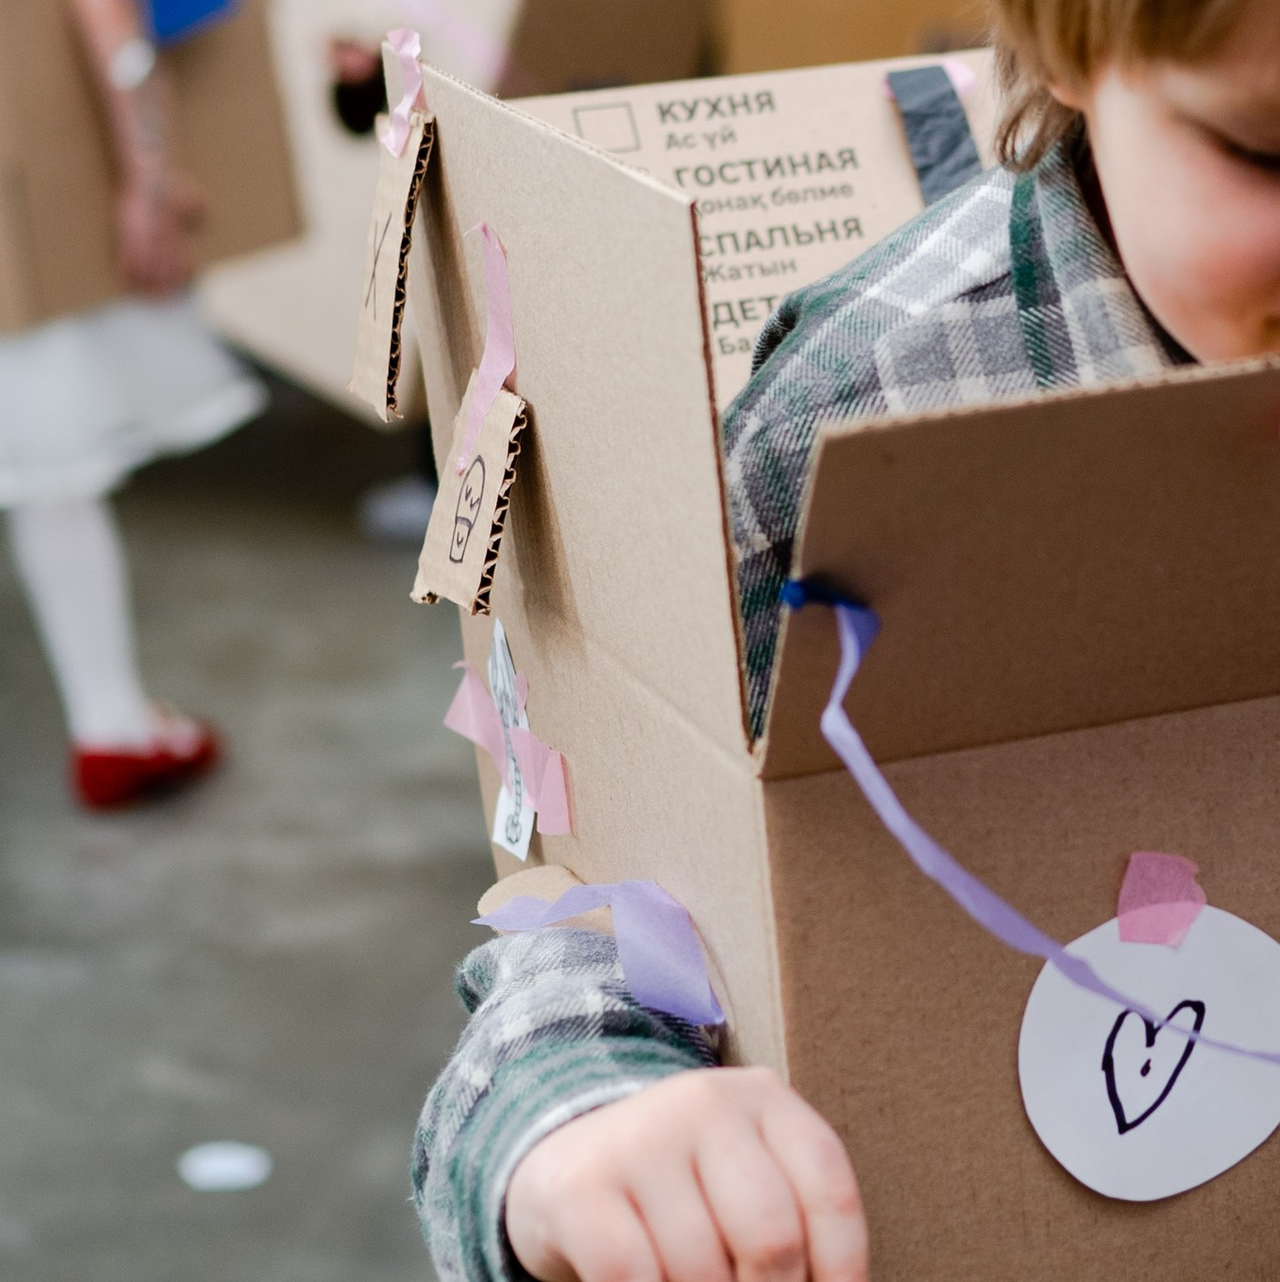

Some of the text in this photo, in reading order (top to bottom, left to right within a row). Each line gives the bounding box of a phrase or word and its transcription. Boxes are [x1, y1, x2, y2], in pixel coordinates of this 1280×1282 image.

[657, 90, 775, 124] КУХНЯ
[665, 132, 697, 150] Ас
[675, 148, 858, 186] ГОСТИНАЯ
[694, 191, 768, 217] онақ
[699, 217, 862, 256] СПАЛЬНЯ
[704, 258, 797, 284] Жатын
